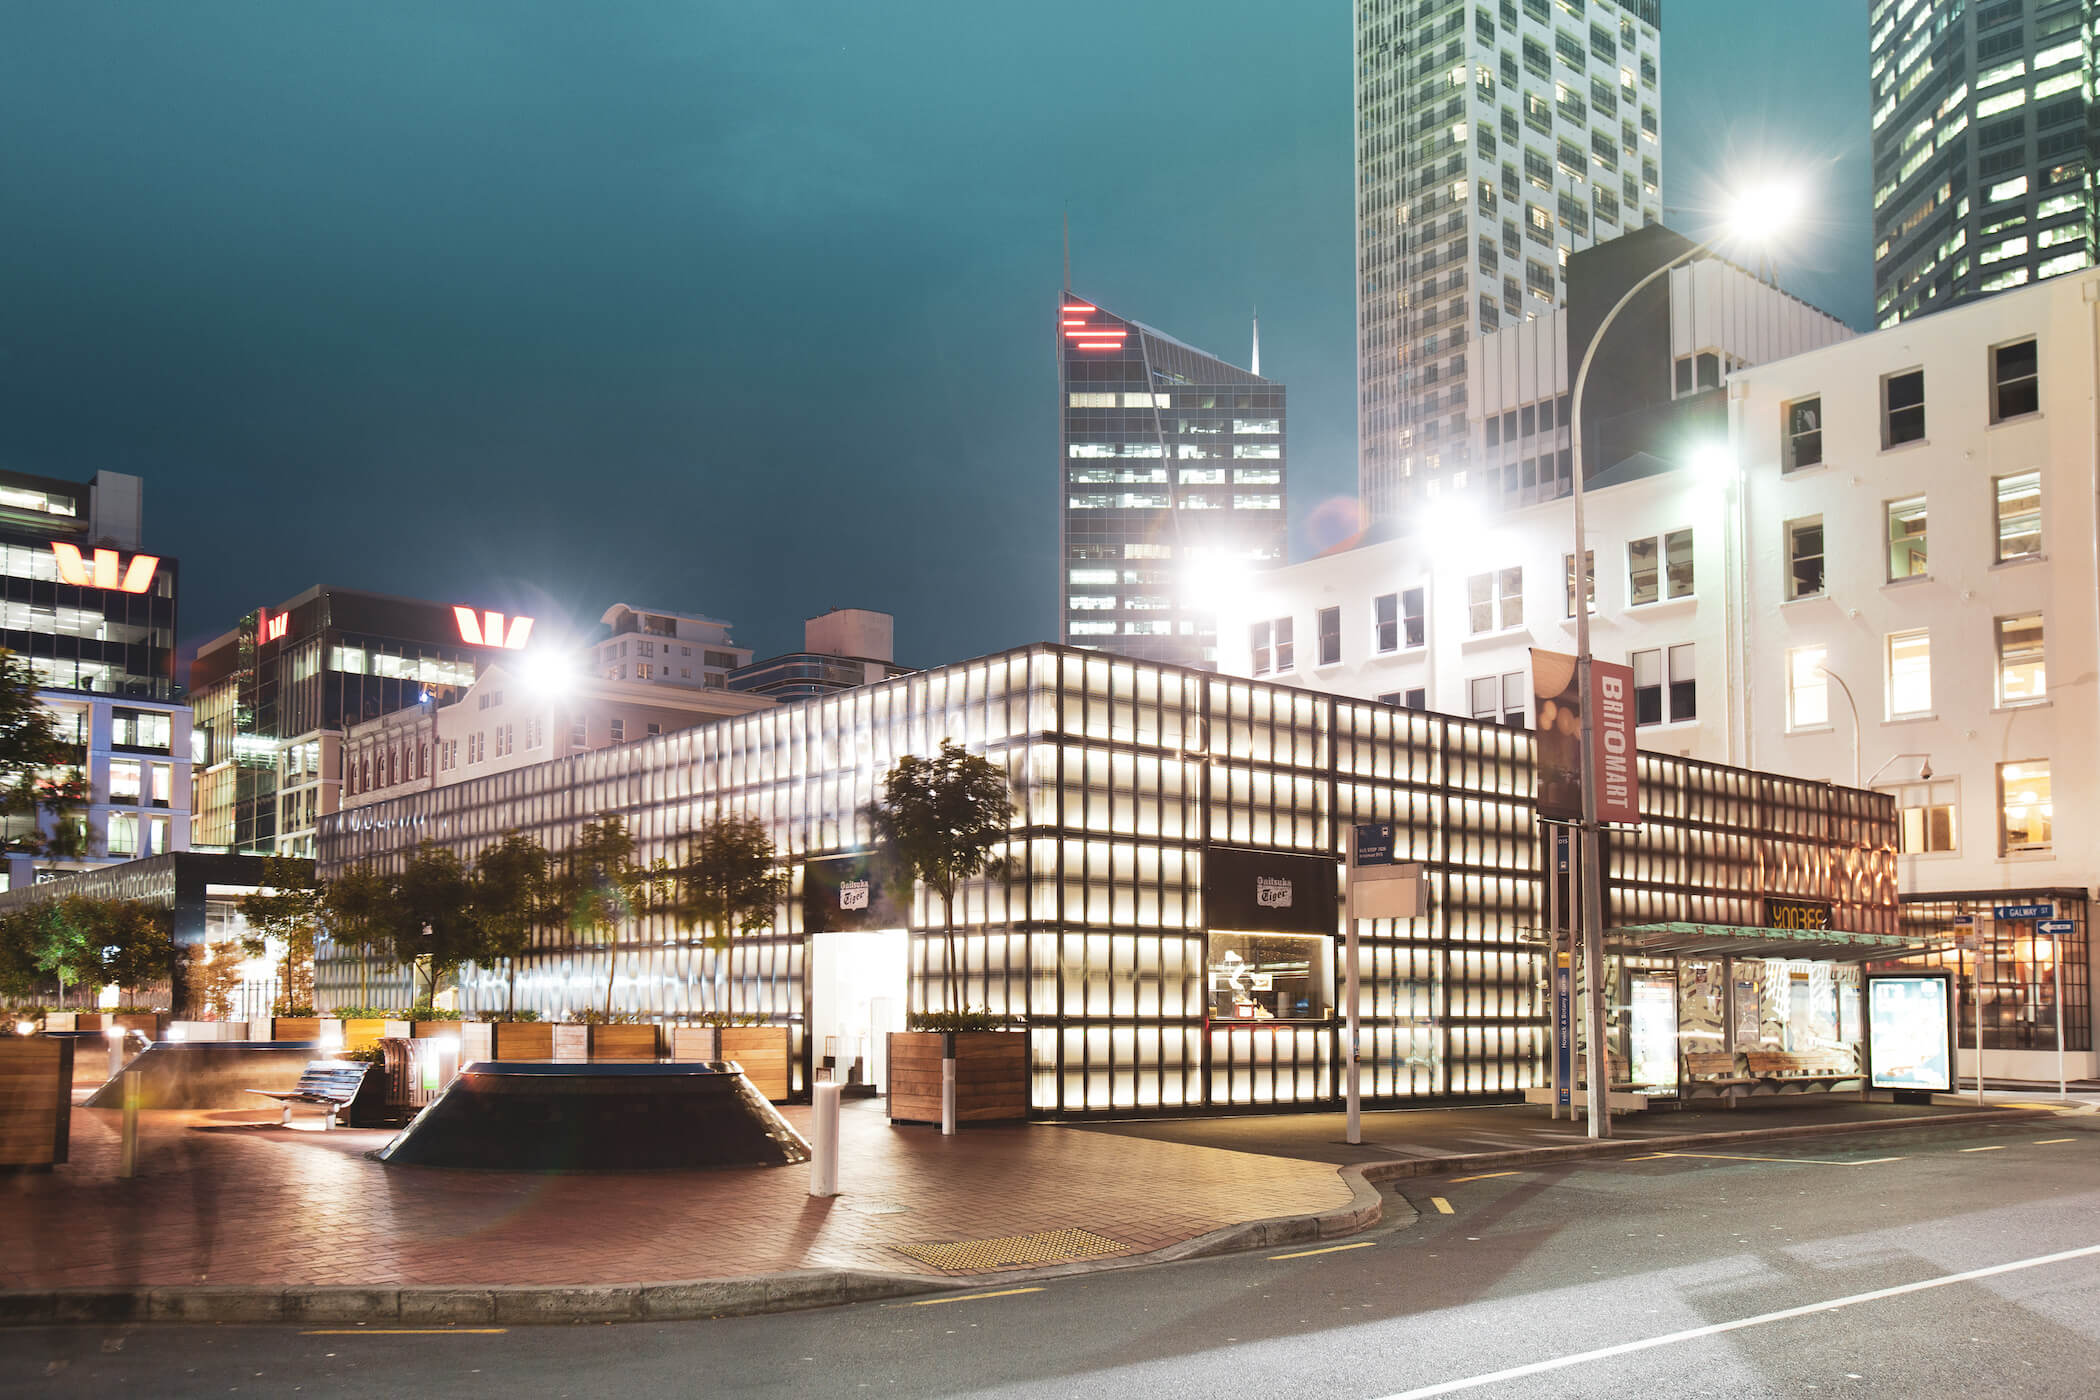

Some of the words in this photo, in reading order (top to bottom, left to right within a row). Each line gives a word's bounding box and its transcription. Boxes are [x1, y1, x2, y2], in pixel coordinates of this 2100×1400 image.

[1602, 676, 1628, 808] BRITOMART
[843, 891, 865, 906] Tiger
[1262, 888, 1288, 902] Tiger
[2009, 909, 2037, 917] GALWAY
